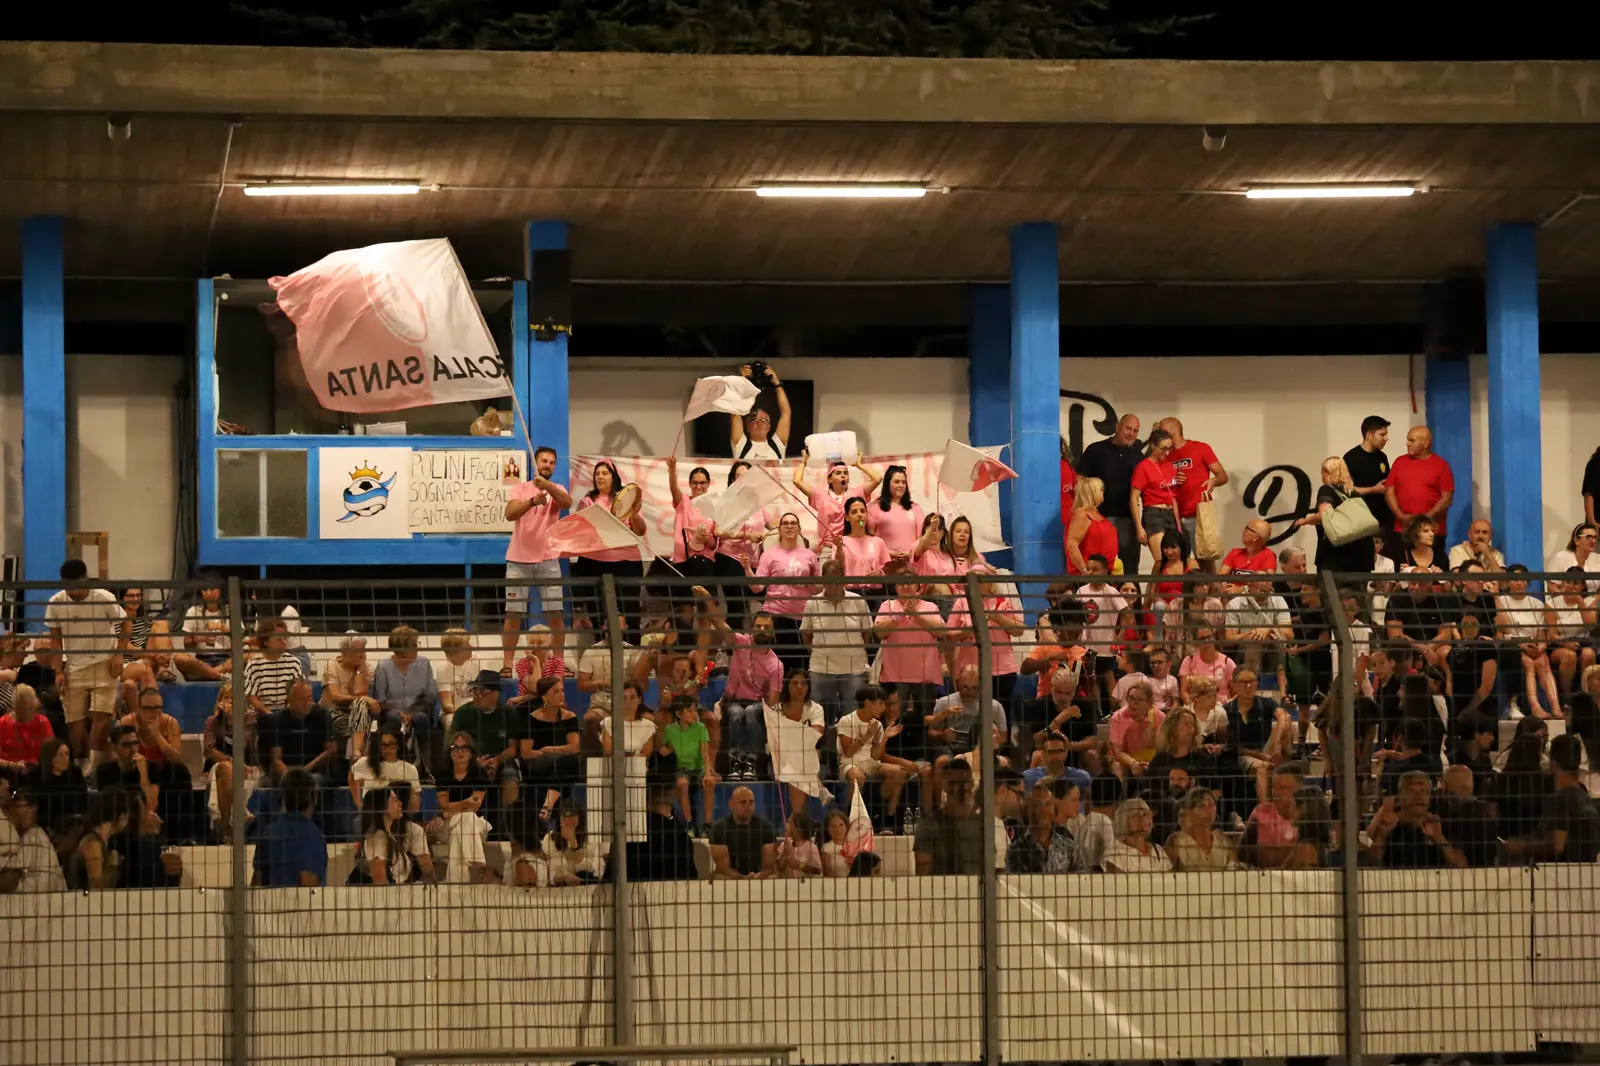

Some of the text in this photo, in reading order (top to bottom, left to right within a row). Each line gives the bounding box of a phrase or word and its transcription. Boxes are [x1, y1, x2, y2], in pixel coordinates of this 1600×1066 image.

[409, 481, 508, 502] SOGNARE SCAL
[409, 508, 451, 527] SANTA
[454, 509, 472, 523] DEVE
